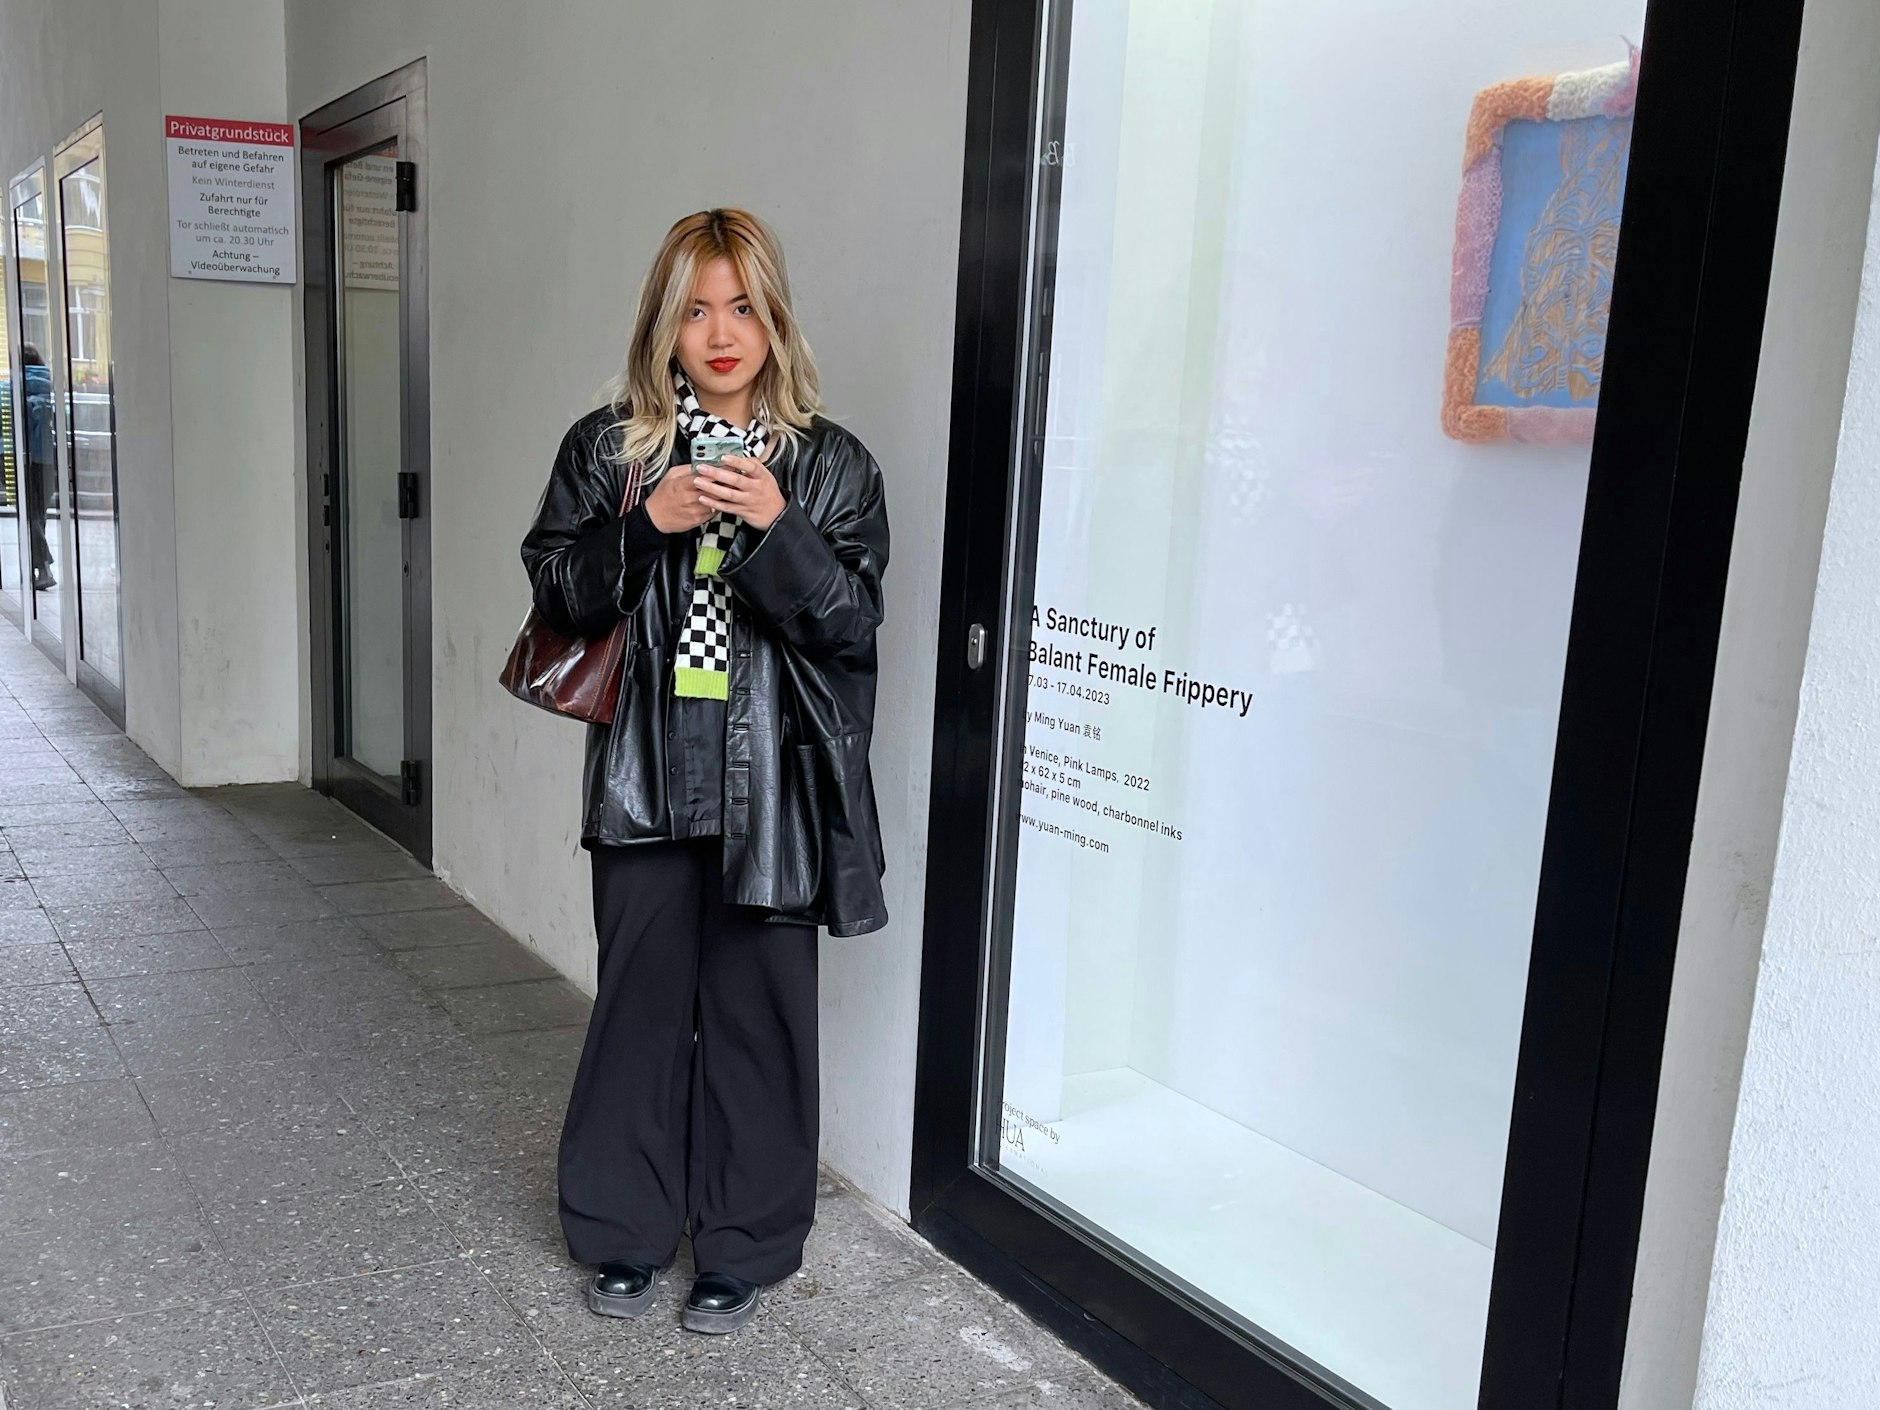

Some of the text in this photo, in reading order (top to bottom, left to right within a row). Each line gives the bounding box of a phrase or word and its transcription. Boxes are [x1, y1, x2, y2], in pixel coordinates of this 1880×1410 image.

[170, 121, 289, 143] Privatgrundstück
[178, 146, 284, 162] Betreten und Befahren
[191, 160, 275, 174] auf eigene Gefahr
[192, 176, 275, 190] Kein Winterdienst
[199, 192, 268, 206] Zufahrt nur für
[208, 205, 261, 219] Berechtigte
[177, 220, 289, 235] Tor schließt automatisch
[195, 235, 275, 246] um ca. 20.30 Uhr
[212, 249, 251, 262] Achtung
[190, 261, 281, 276] Videoüberwachung
[1030, 605, 1157, 651] A Sanctury of
[1027, 674, 1048, 690] 7.03
[1057, 681, 1110, 705] 17.04.2023
[1028, 640, 1253, 718] Balant Female Frippery
[1034, 711, 1056, 730] Ming
[1058, 717, 1081, 735] Yuan
[1029, 744, 1061, 767] Venice,
[1063, 755, 1083, 772] Pink
[1124, 773, 1151, 792] 2022
[1031, 765, 1036, 775] x
[1038, 765, 1050, 779] 62
[1051, 771, 1057, 781] x
[1059, 772, 1066, 784] 5
[1067, 777, 1081, 789] cm
[1051, 788, 1071, 804] pine
[1072, 796, 1100, 816] wood,
[1103, 805, 1159, 832] charbonnel
[1160, 821, 1183, 841] inks
[1019, 812, 1110, 853] ww.yuan-ming.com
[1025, 1114, 1049, 1136] space
[1050, 1127, 1061, 1145] by
